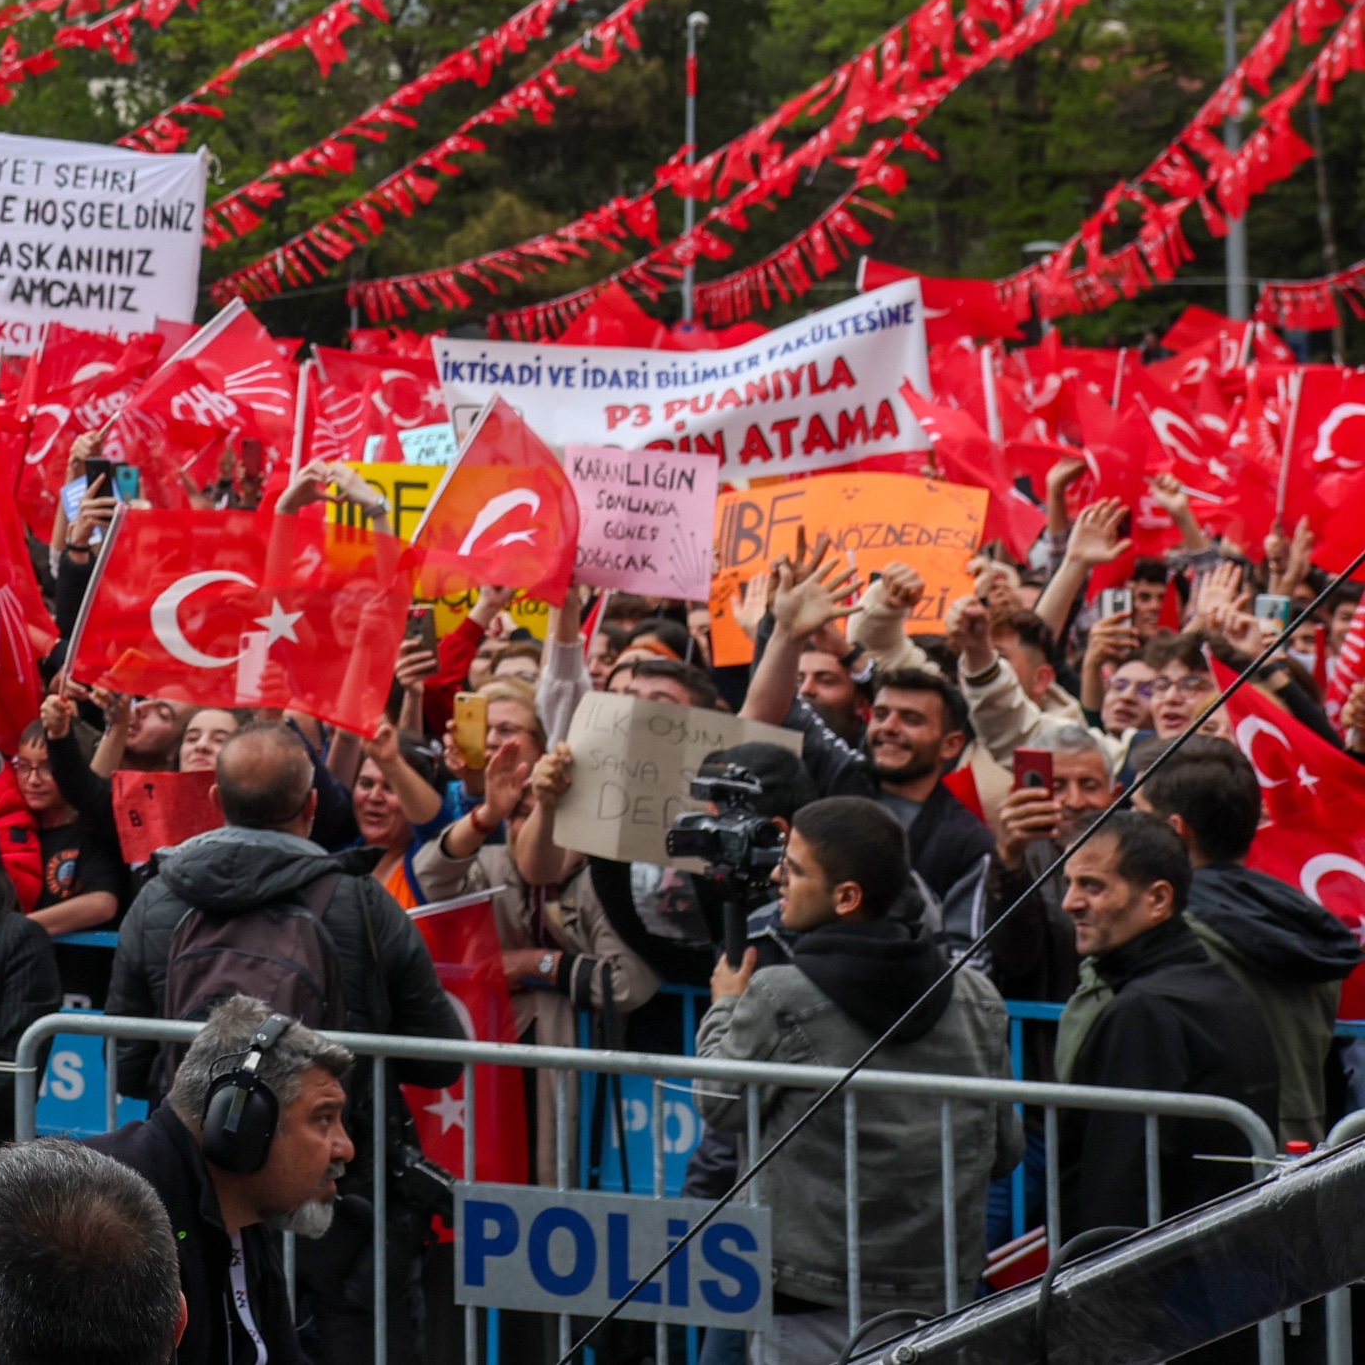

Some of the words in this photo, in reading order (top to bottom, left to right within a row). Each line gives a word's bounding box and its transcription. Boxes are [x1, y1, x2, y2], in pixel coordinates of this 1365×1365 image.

[54, 163, 137, 193] ŞEHRİ
[24, 197, 196, 232] HOŞGELDİNİZ
[10, 276, 138, 313] AMCAMIZ
[442, 350, 541, 386] İKTİSADİ
[548, 366, 576, 388] VE
[582, 357, 648, 390] İDARİ
[655, 354, 760, 390] BİLİMLER
[768, 299, 916, 362] FAKÜLTESİNE
[605, 403, 651, 430] P3
[663, 355, 856, 422] PUANIYLA
[739, 398, 900, 466] ATAMA
[463, 1199, 762, 1315] POLİS
